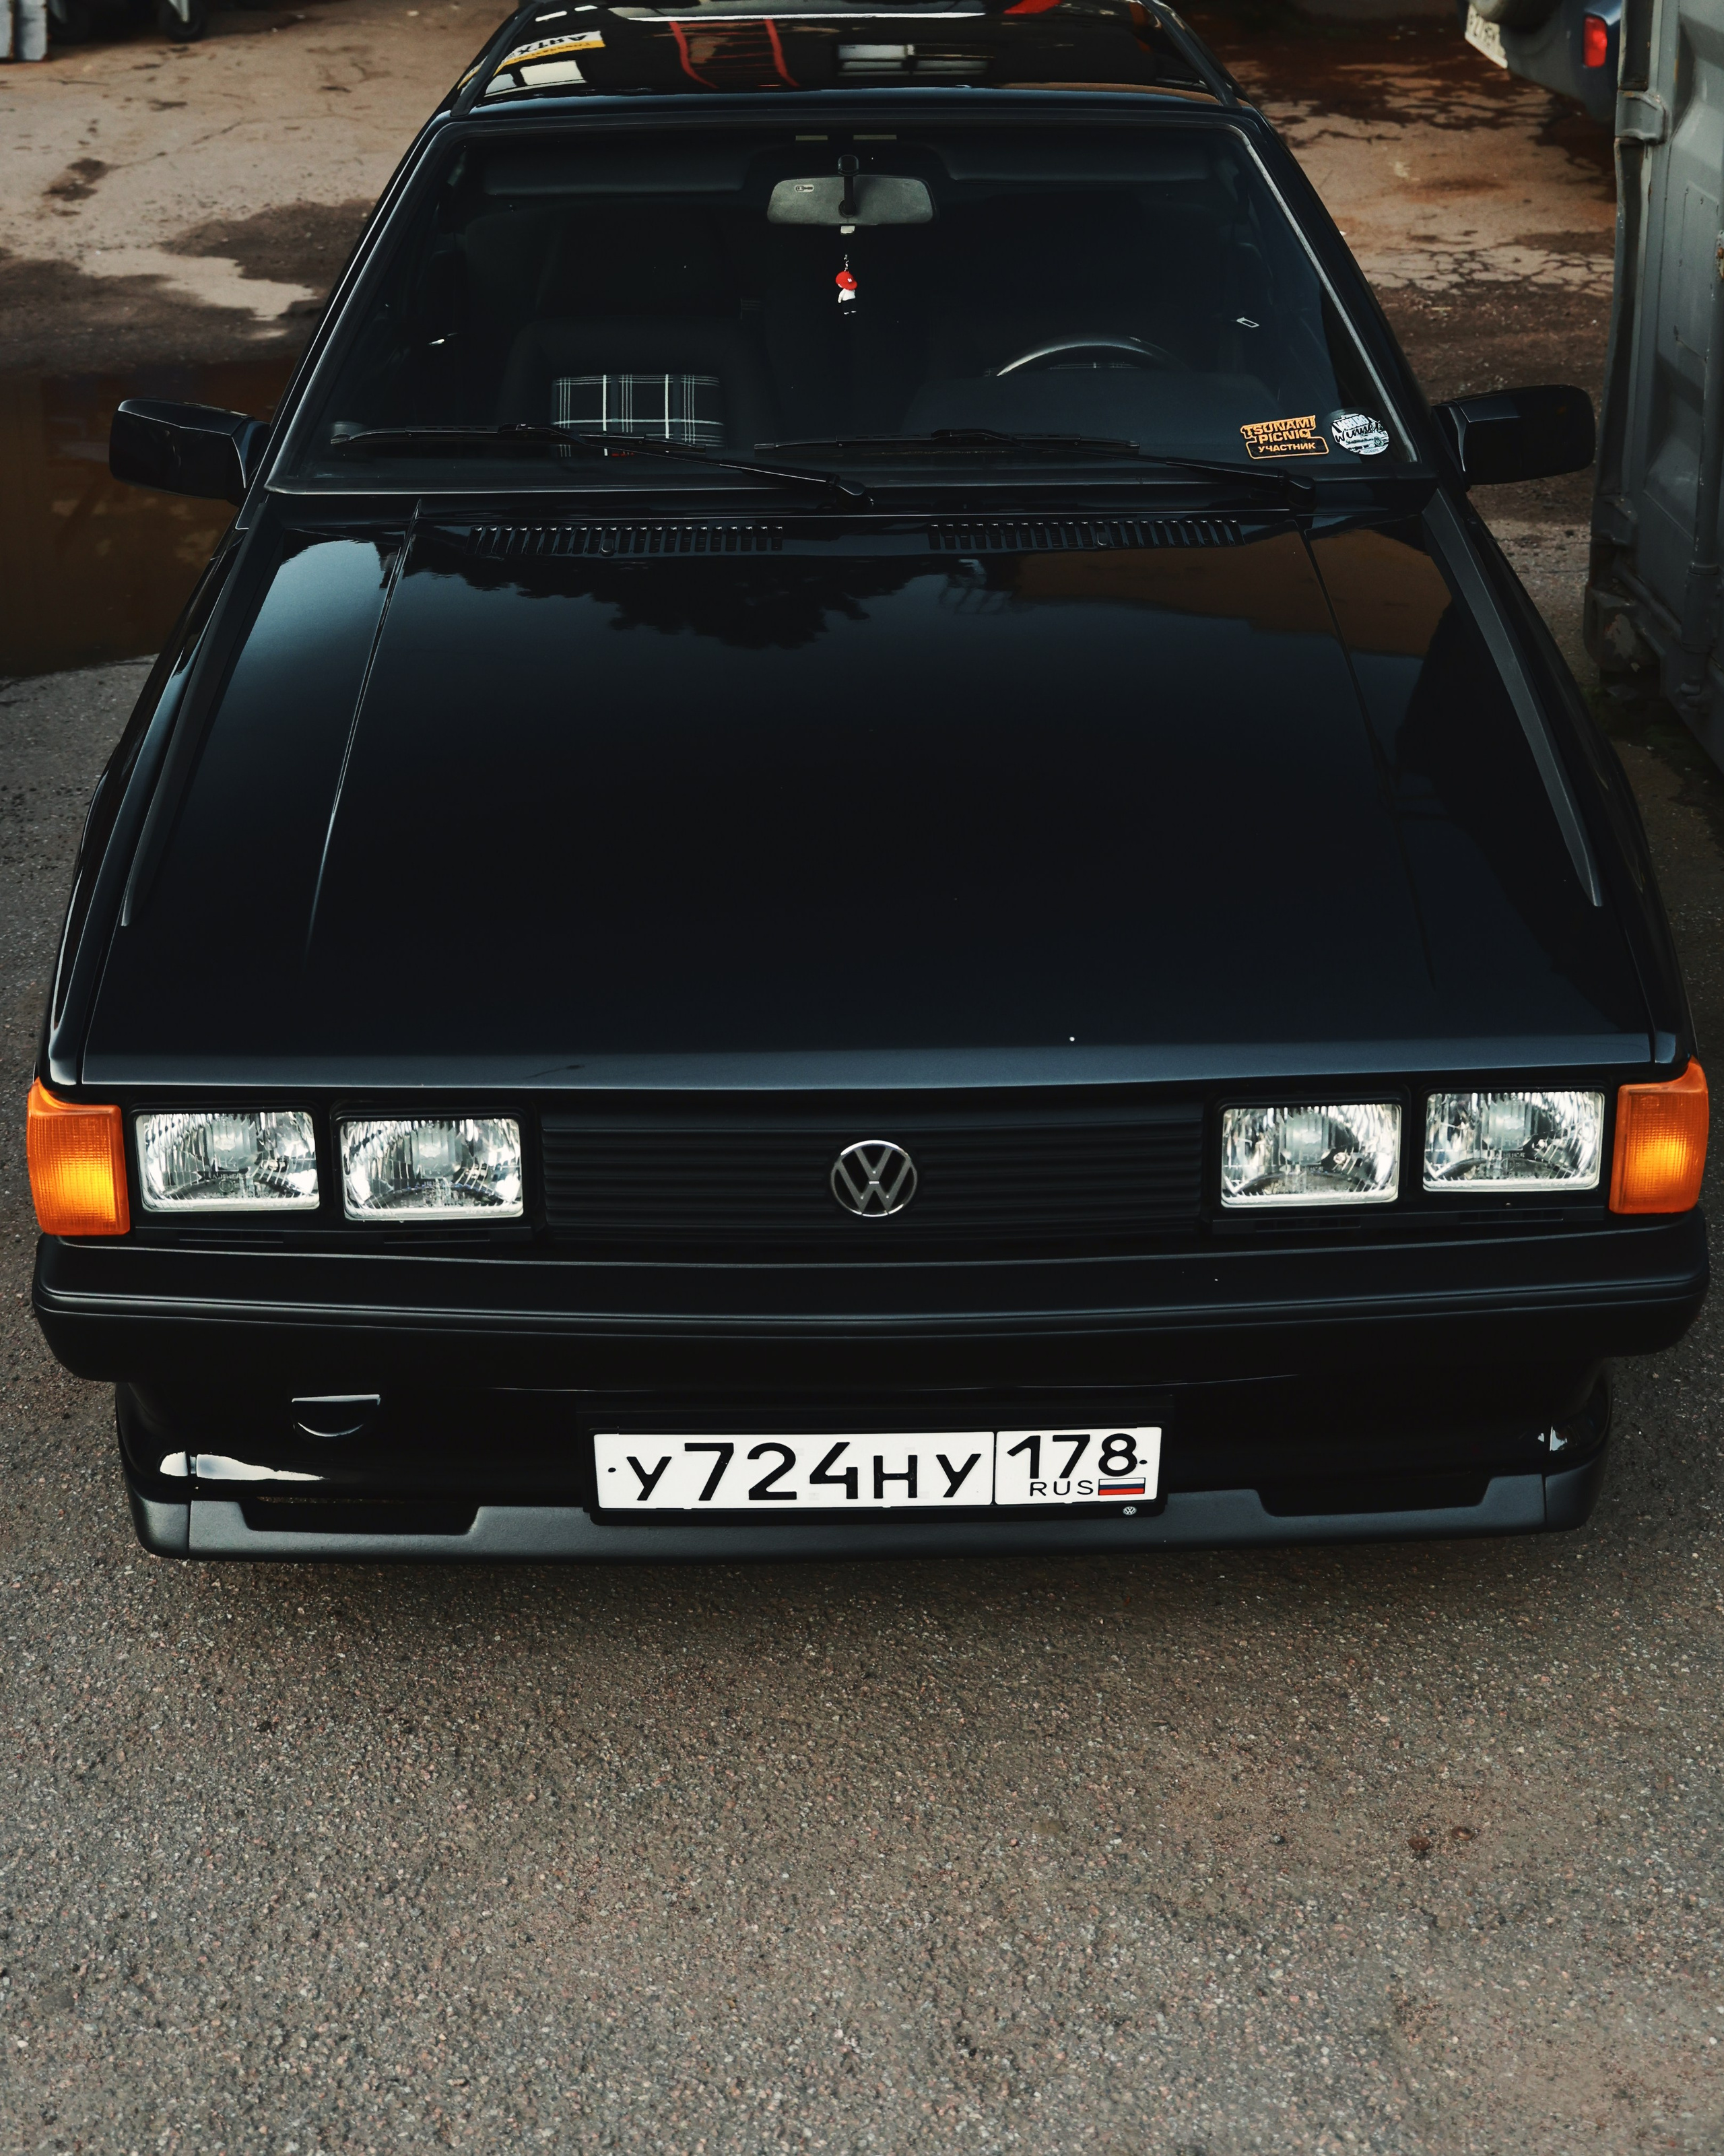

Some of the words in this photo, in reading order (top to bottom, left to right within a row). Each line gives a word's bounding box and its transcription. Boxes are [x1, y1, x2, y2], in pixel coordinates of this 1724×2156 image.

[1244, 417, 1315, 436] TSUNAMI
[1258, 428, 1311, 444] PICNIC
[1257, 442, 1316, 453] УЧАСТНИК
[1007, 1433, 1139, 1479] 178
[1028, 1479, 1094, 1497] RUS
